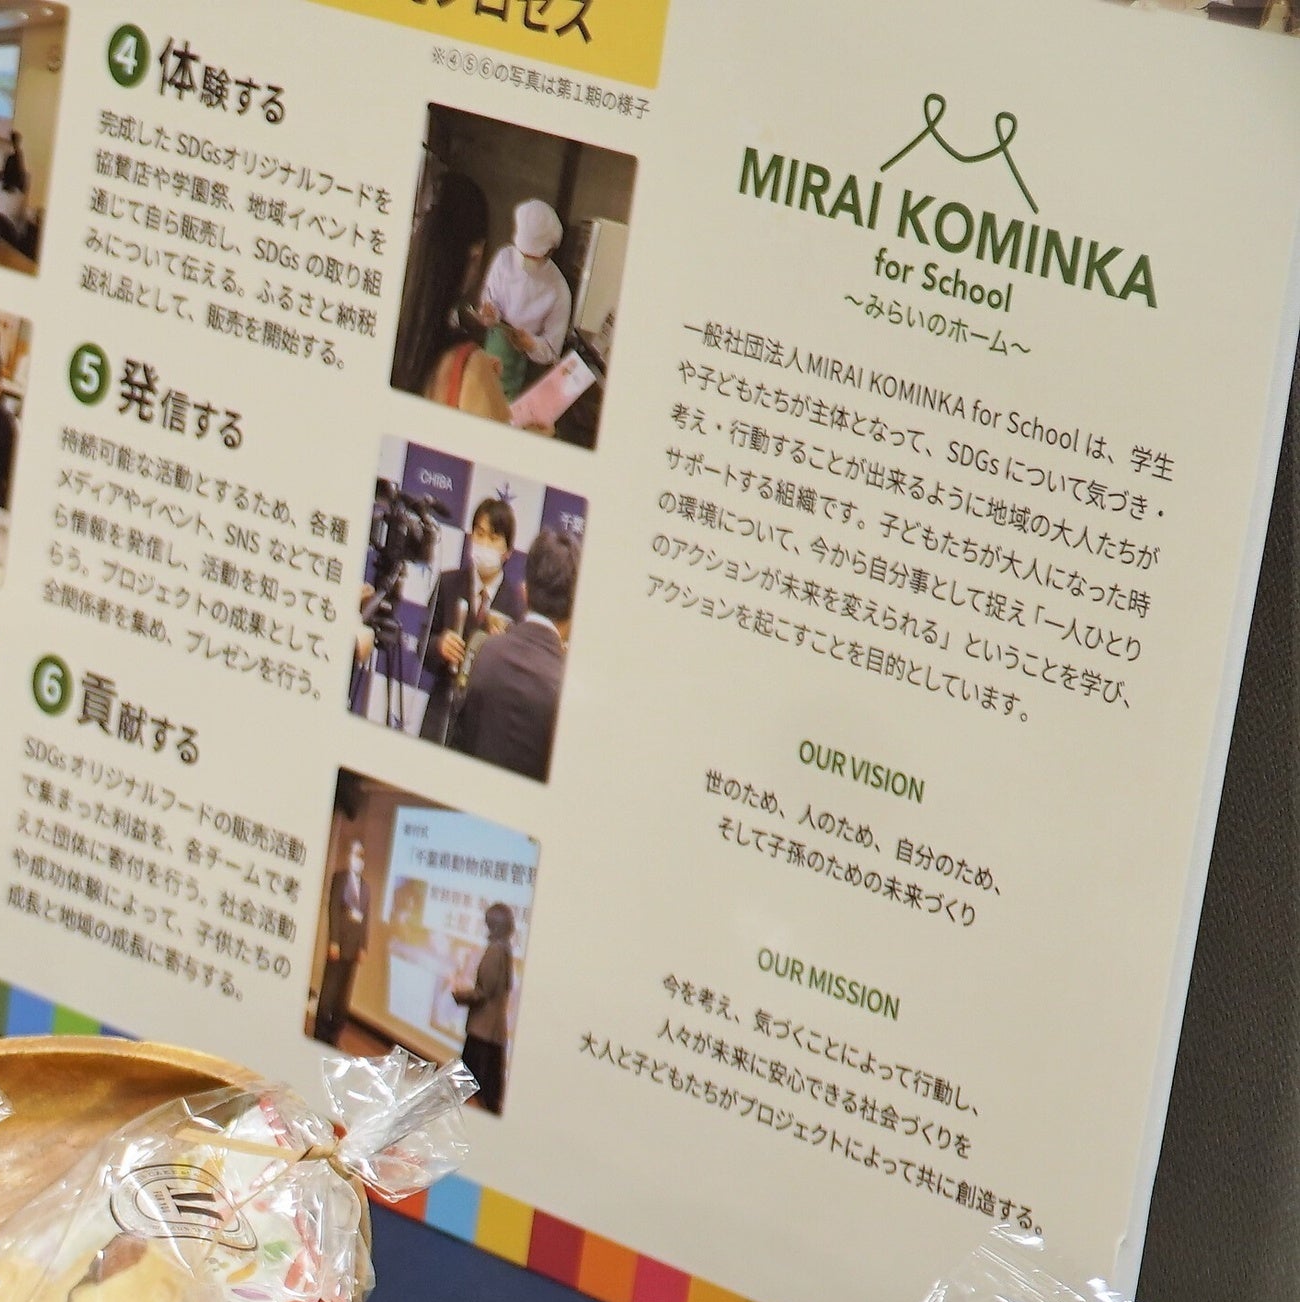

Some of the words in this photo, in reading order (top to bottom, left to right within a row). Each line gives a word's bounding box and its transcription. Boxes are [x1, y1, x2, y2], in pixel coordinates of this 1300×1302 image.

[157, 37, 287, 125] 体験する
[738, 146, 883, 231] MIRAI
[896, 188, 1158, 309] KOMINKA
[874, 246, 915, 283] for
[921, 261, 1014, 313] School
[117, 357, 244, 451] 発信する
[868, 370, 967, 422] KOMINKA
[971, 399, 1003, 427] for
[1006, 410, 1080, 450] School
[664, 446, 1153, 622] サポートする組織です。子どもたちが大人になった時
[646, 573, 1031, 725] アクションを起こすことを目的としています。
[77, 670, 200, 766] 貢献する
[798, 738, 849, 778] OUR
[849, 754, 926, 804] VISION
[704, 767, 1003, 898] 世のため、人のため、自分のため、
[717, 814, 977, 928] そして子孫のための未来づくり
[757, 946, 804, 986] OUR
[806, 964, 901, 1022] MISSION
[656, 1017, 972, 1162] 人々が未来に安心できる社会づくりを
